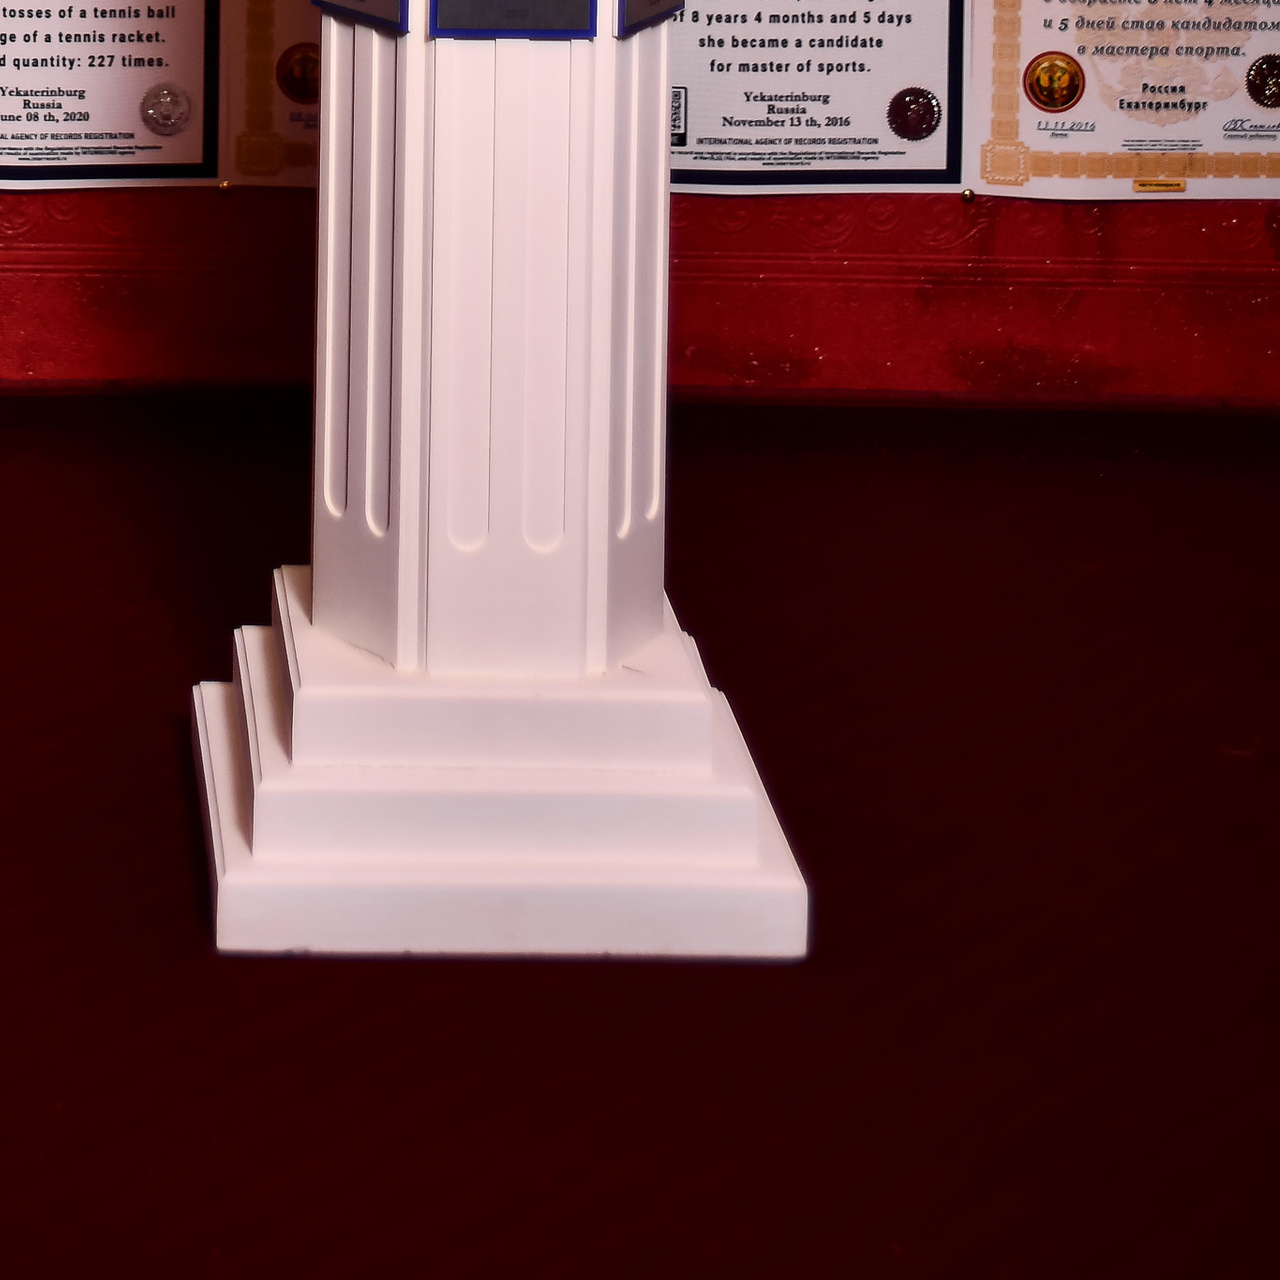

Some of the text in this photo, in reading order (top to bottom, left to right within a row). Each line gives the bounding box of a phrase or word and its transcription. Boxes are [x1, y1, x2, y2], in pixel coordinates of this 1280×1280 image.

[12, 54, 81, 71] quantity:
[87, 54, 115, 68] 227
[121, 53, 170, 68] times.
[709, 58, 871, 75] for master of sports.
